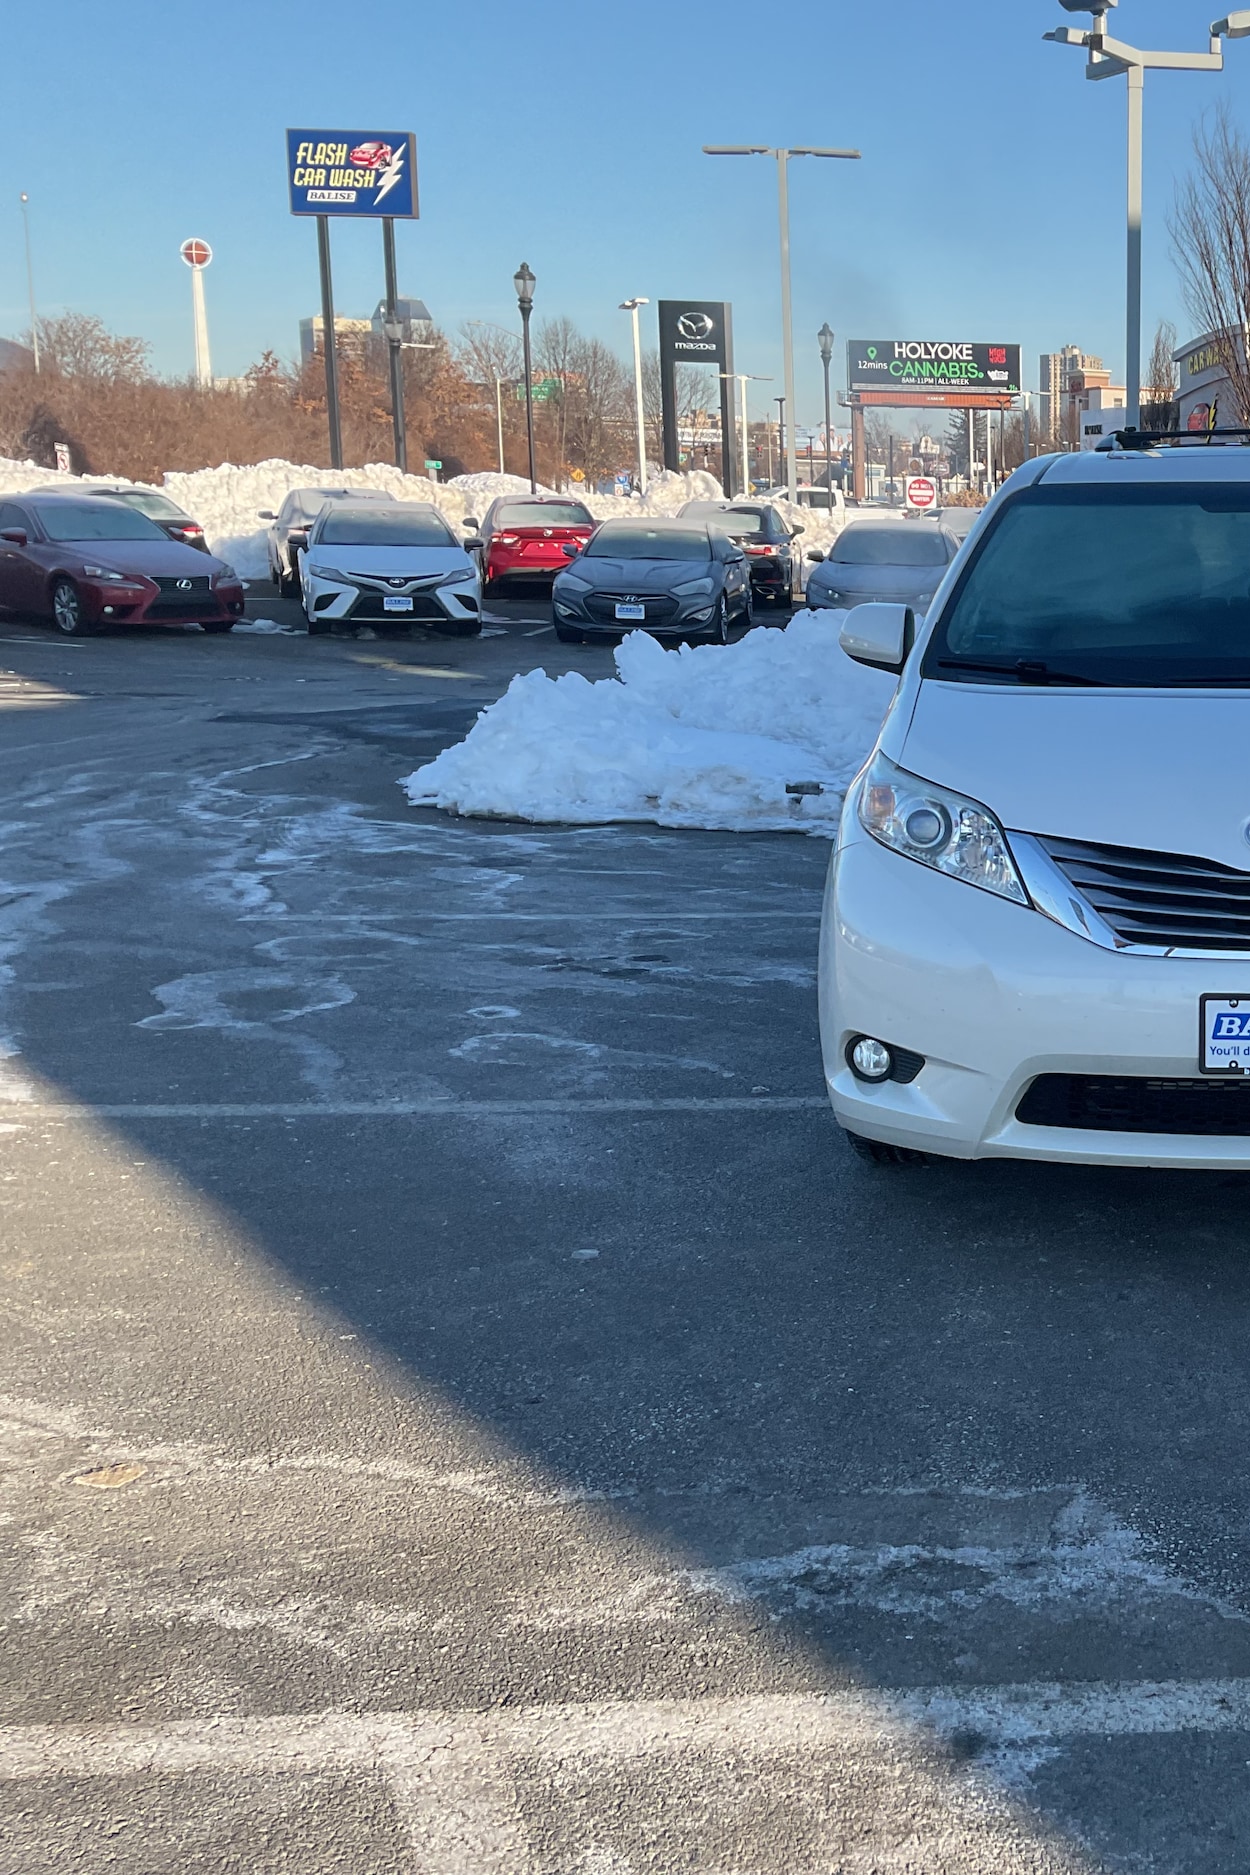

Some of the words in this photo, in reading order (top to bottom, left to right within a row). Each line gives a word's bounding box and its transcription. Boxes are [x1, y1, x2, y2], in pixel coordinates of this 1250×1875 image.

[296, 142, 348, 166] FLASH
[293, 168, 326, 187] CAR
[329, 169, 376, 188] WASH
[309, 191, 355, 201] BALISE
[894, 342, 973, 360] HOLYOKE
[857, 360, 888, 370] 12mins
[1188, 351, 1205, 375] CAR
[901, 377, 934, 385] 8AM-11PM
[937, 378, 970, 386] ALL-WEEK
[1210, 1046, 1239, 1056] You'll
